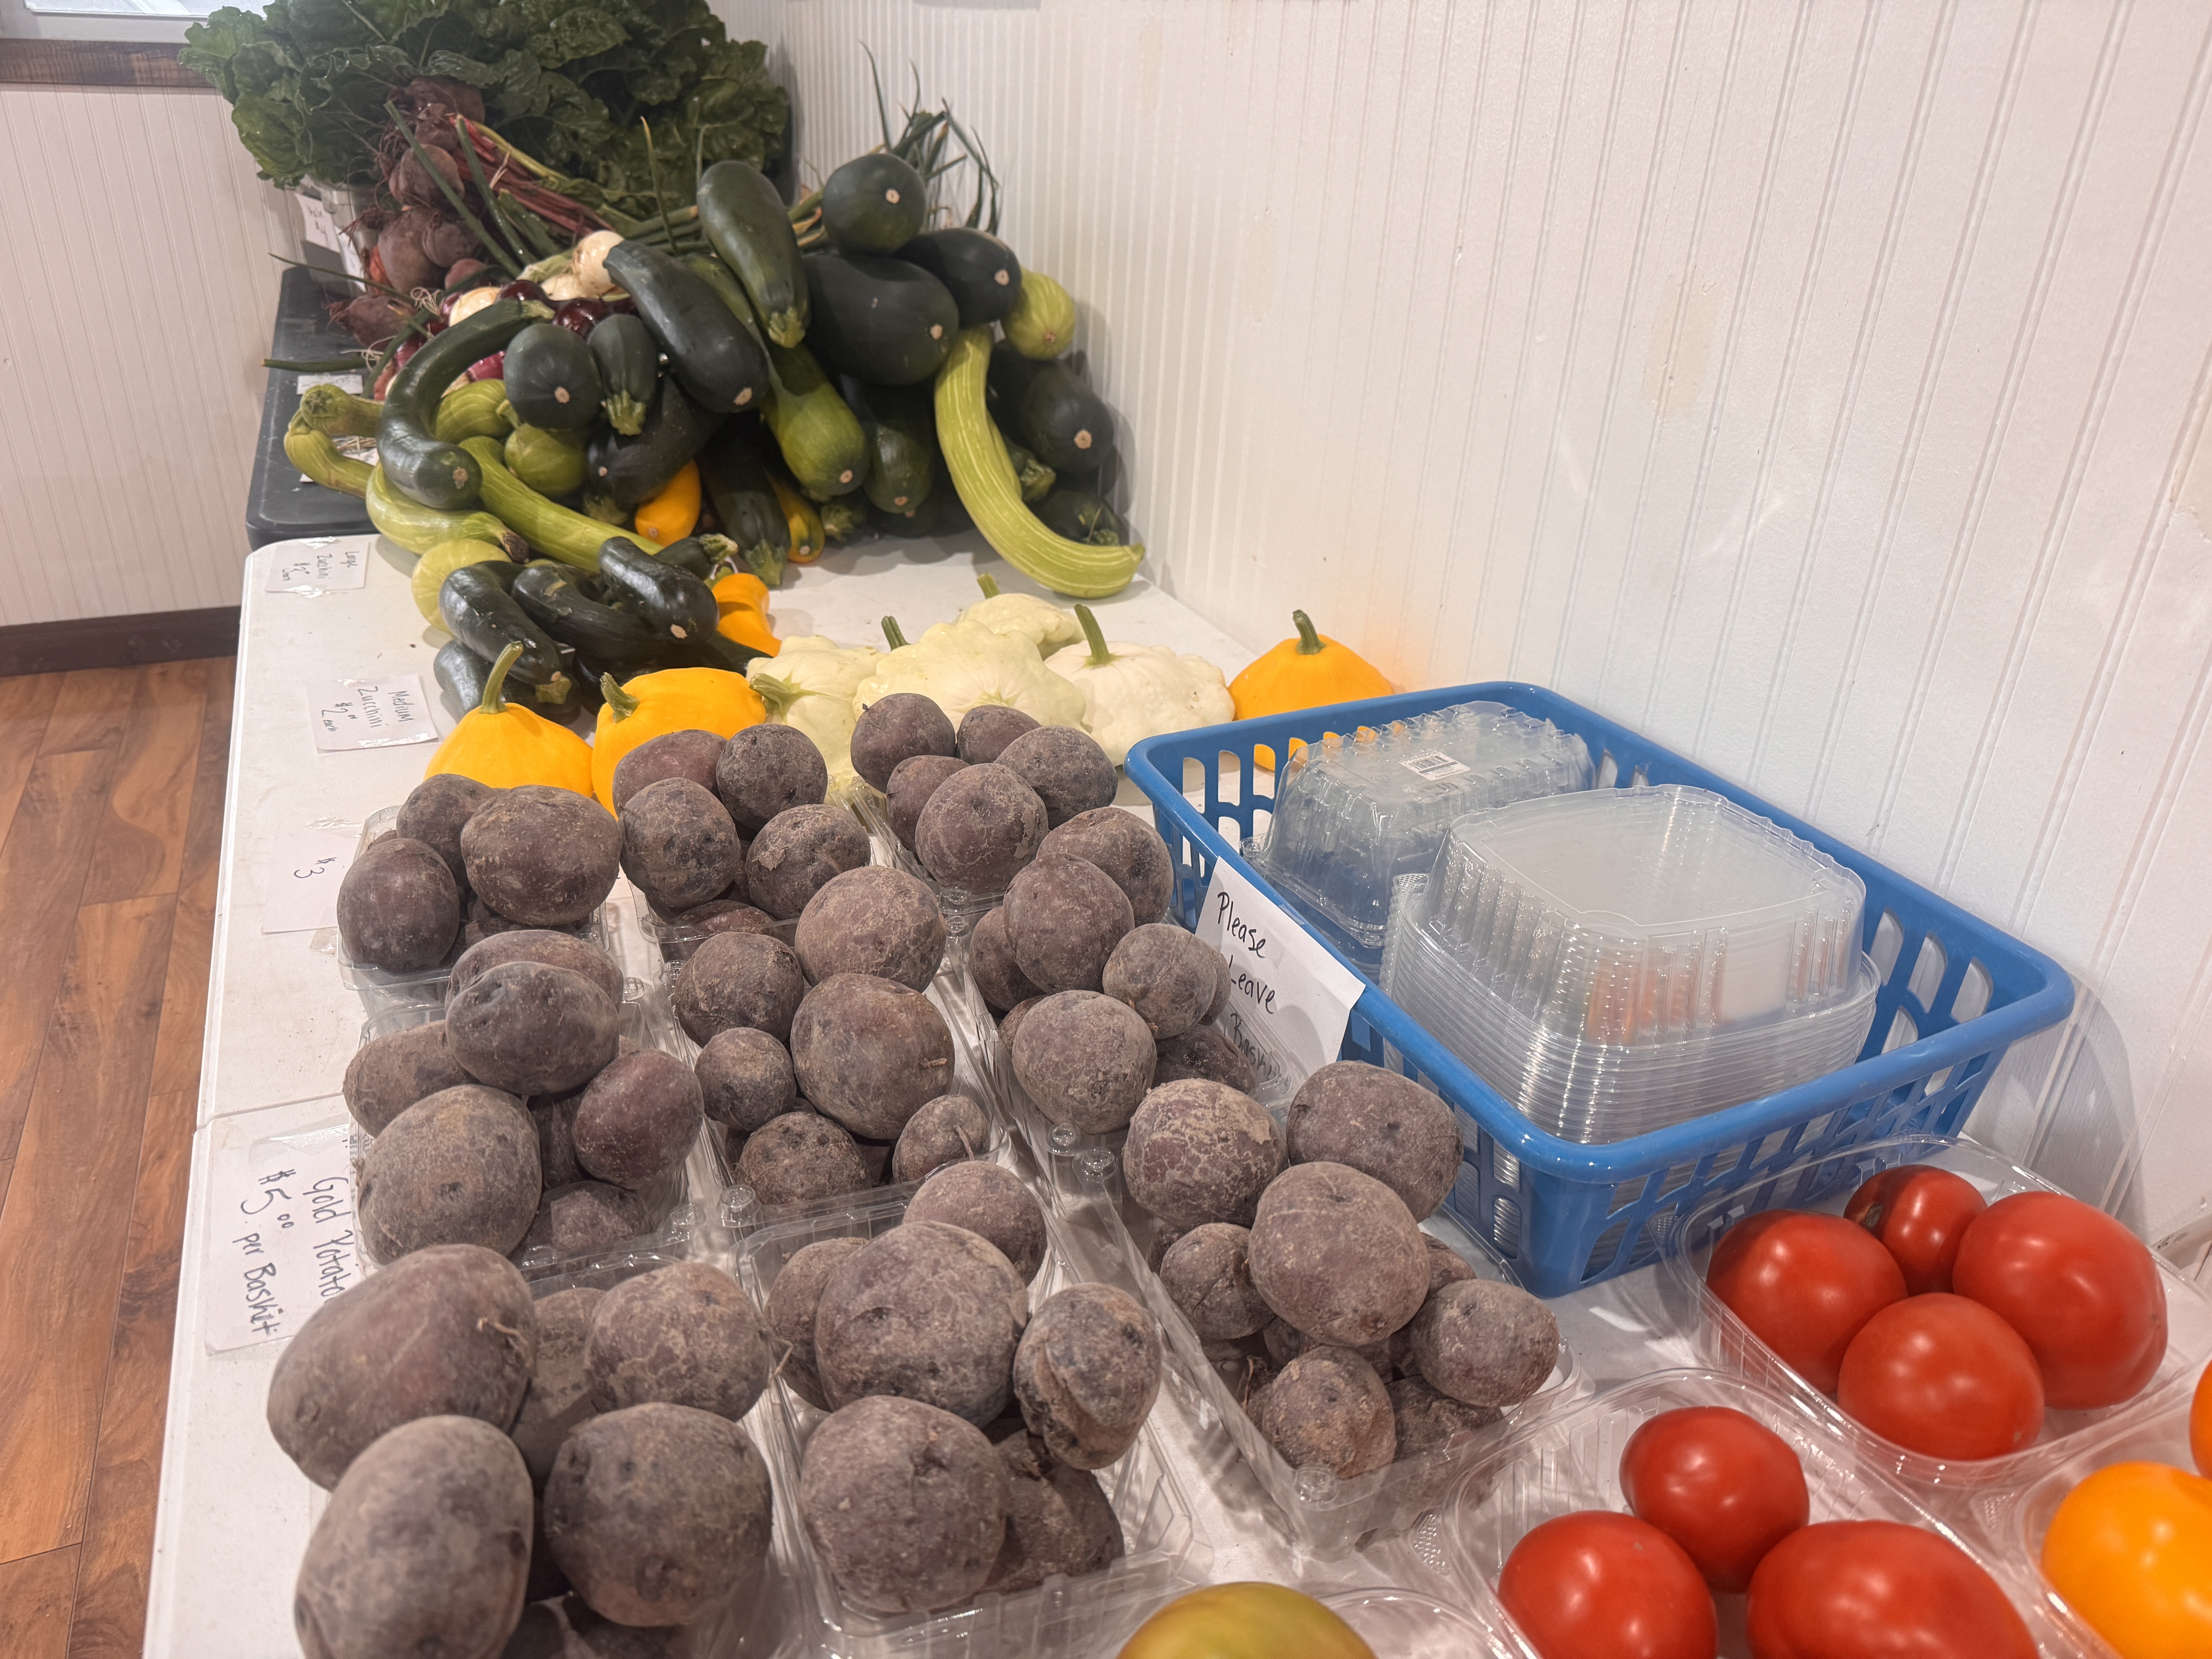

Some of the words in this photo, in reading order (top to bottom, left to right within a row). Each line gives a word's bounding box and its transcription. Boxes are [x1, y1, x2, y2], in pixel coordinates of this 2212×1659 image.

[1217, 891, 1266, 958] Please
[302, 1176, 352, 1224] Gold
[232, 1232, 264, 1255] per
